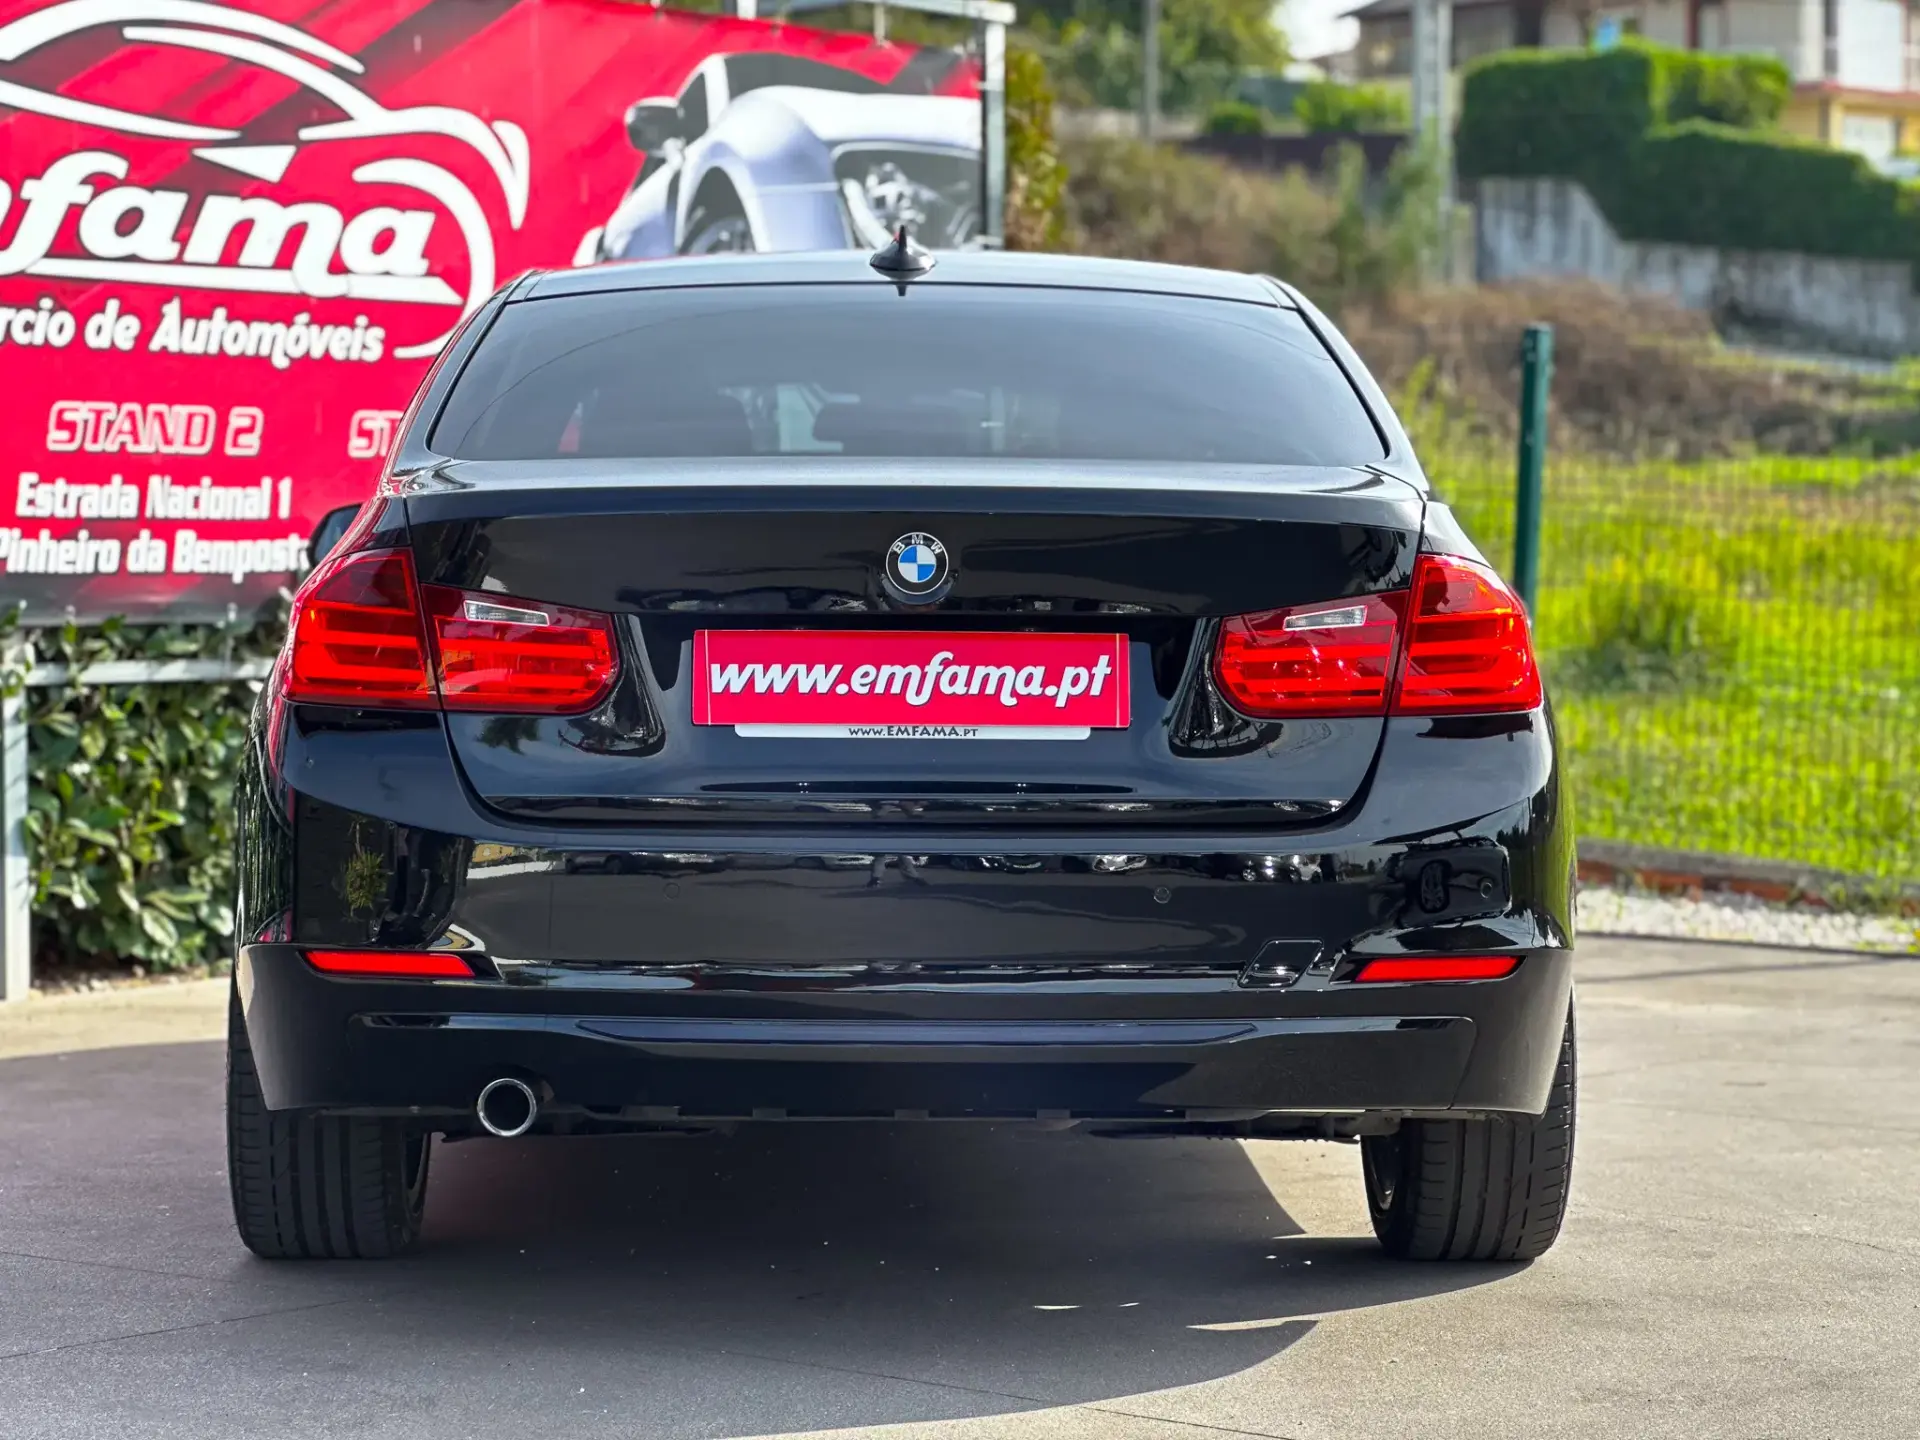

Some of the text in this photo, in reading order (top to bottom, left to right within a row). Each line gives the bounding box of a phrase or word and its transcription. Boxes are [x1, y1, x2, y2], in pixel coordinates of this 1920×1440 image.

[0, 152, 435, 297] fama
[84, 298, 141, 351] de
[46, 401, 264, 456] STAND 2
[16, 472, 293, 520] Estrada Nacional 1
[126, 528, 166, 573] da
[891, 533, 943, 555] BMW
[710, 651, 1112, 707] www.emfama.pt
